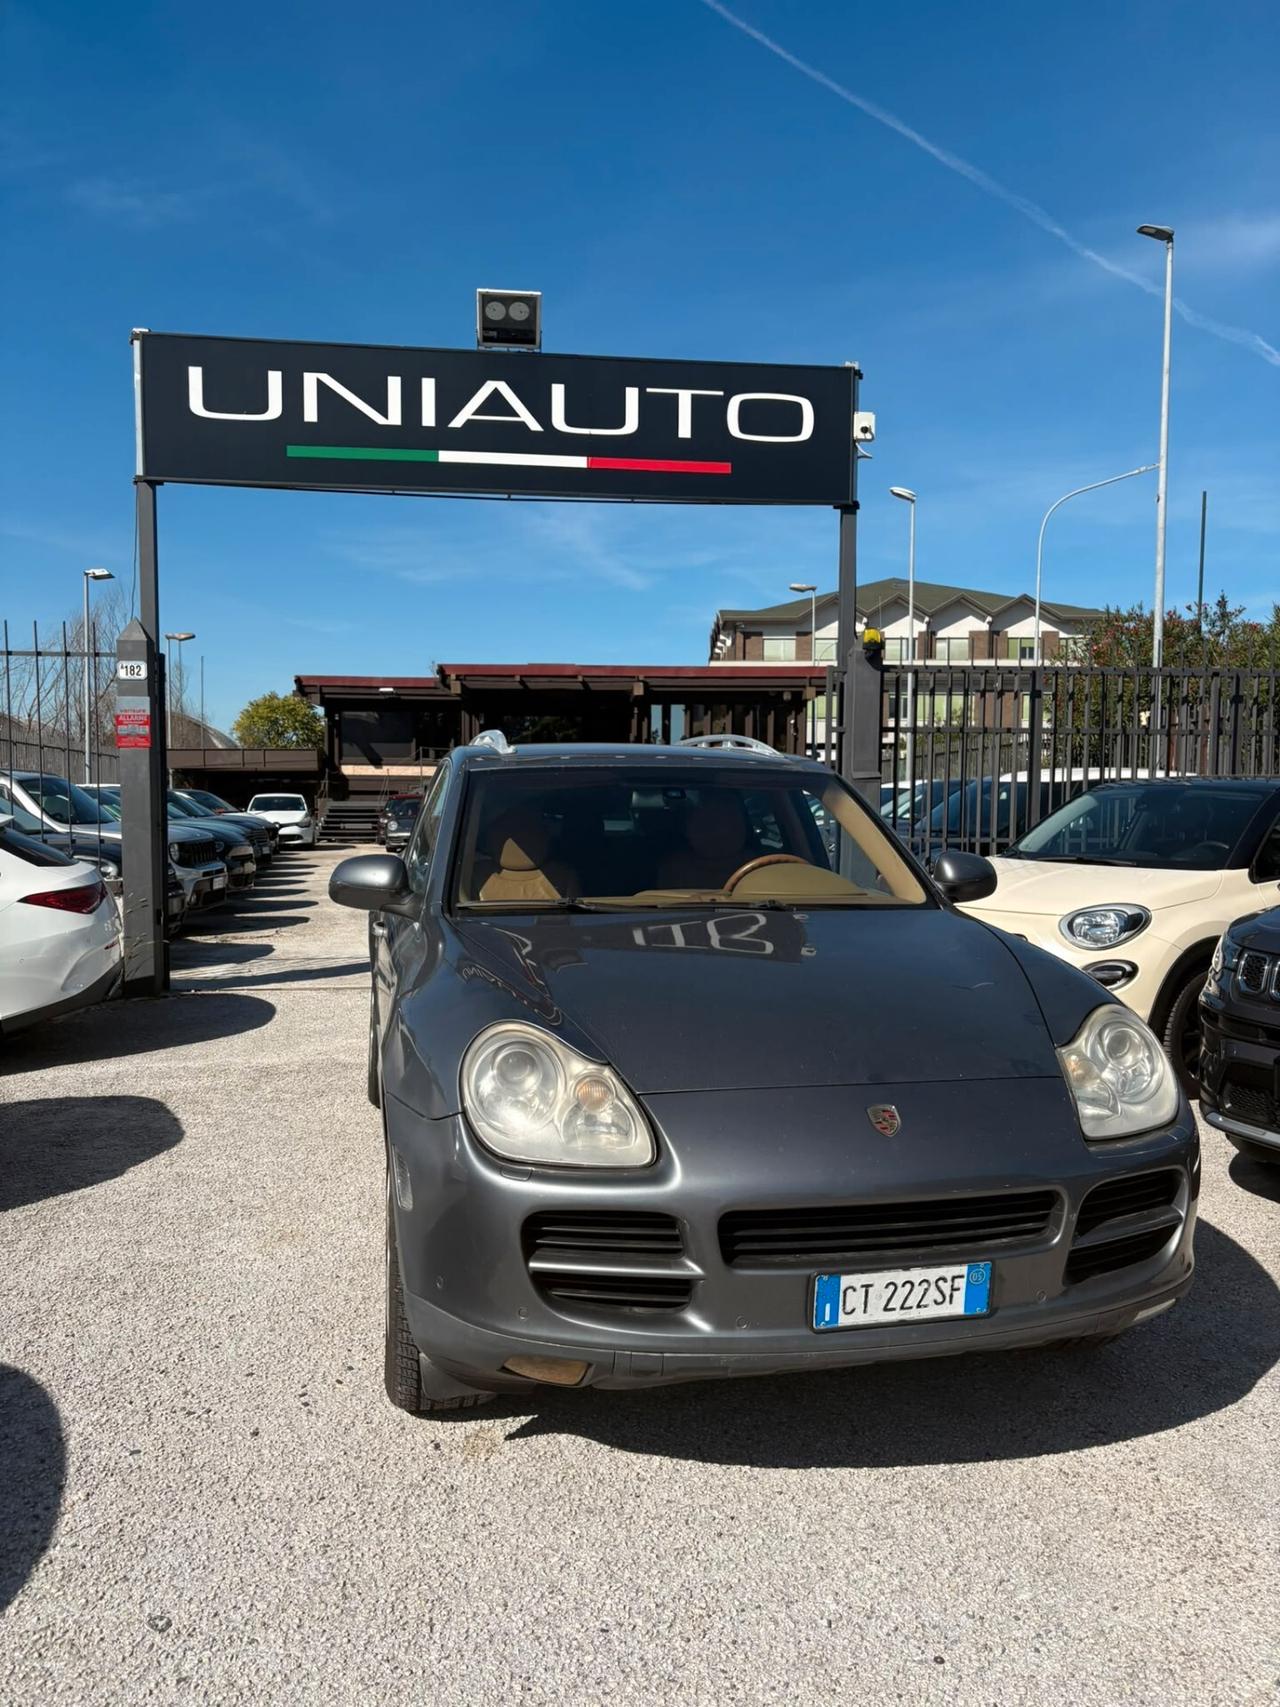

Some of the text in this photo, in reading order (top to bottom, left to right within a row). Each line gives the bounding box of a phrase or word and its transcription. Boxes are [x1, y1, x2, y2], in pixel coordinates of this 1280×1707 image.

[187, 365, 816, 443] UNIAUTO
[842, 1284, 874, 1316] CT
[882, 1274, 966, 1312] 222SF
